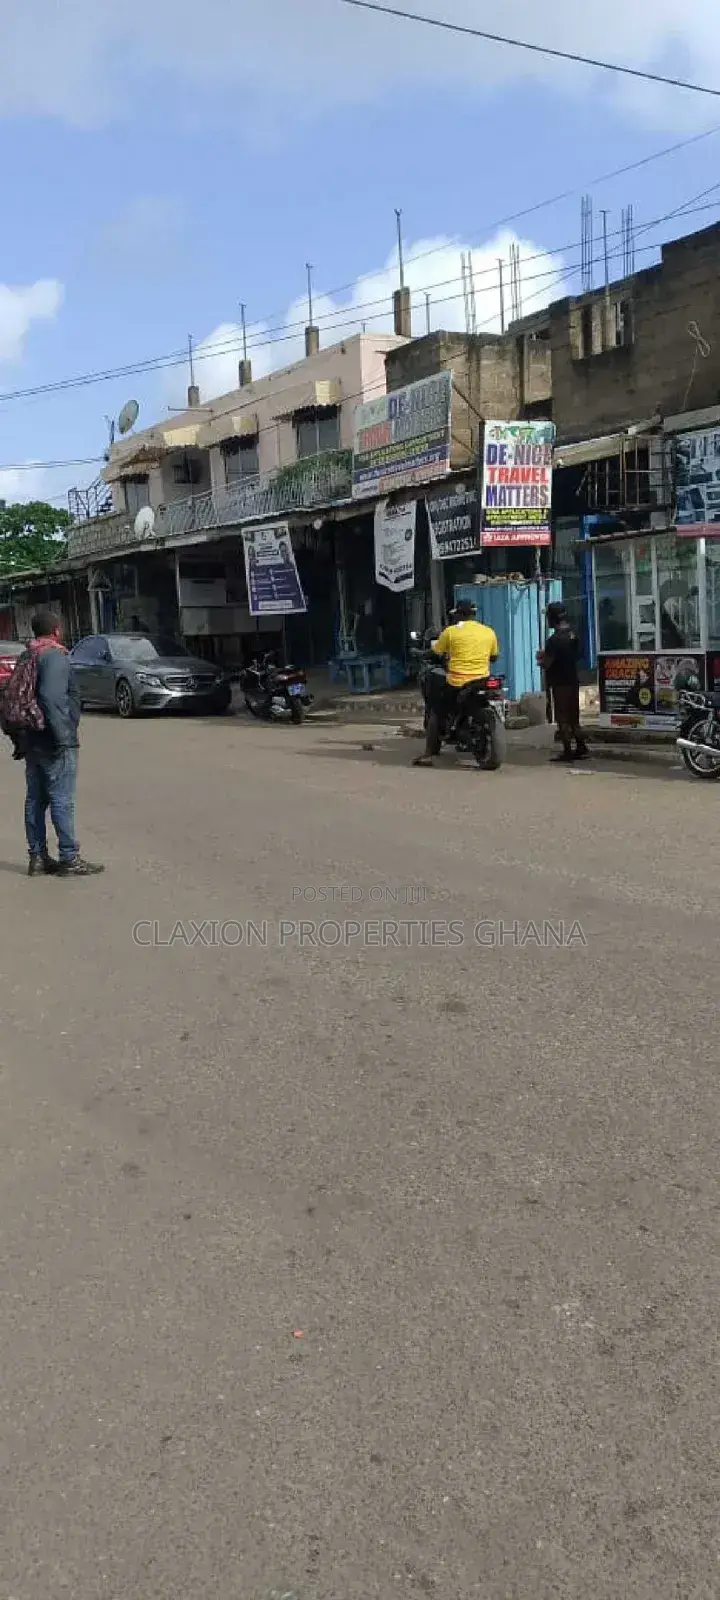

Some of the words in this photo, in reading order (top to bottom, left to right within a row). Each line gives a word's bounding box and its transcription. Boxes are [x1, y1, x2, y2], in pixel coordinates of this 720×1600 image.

[486, 444, 552, 466] DE-NICE
[487, 467, 549, 484] TRAVEL
[485, 485, 549, 507] MATTERS
